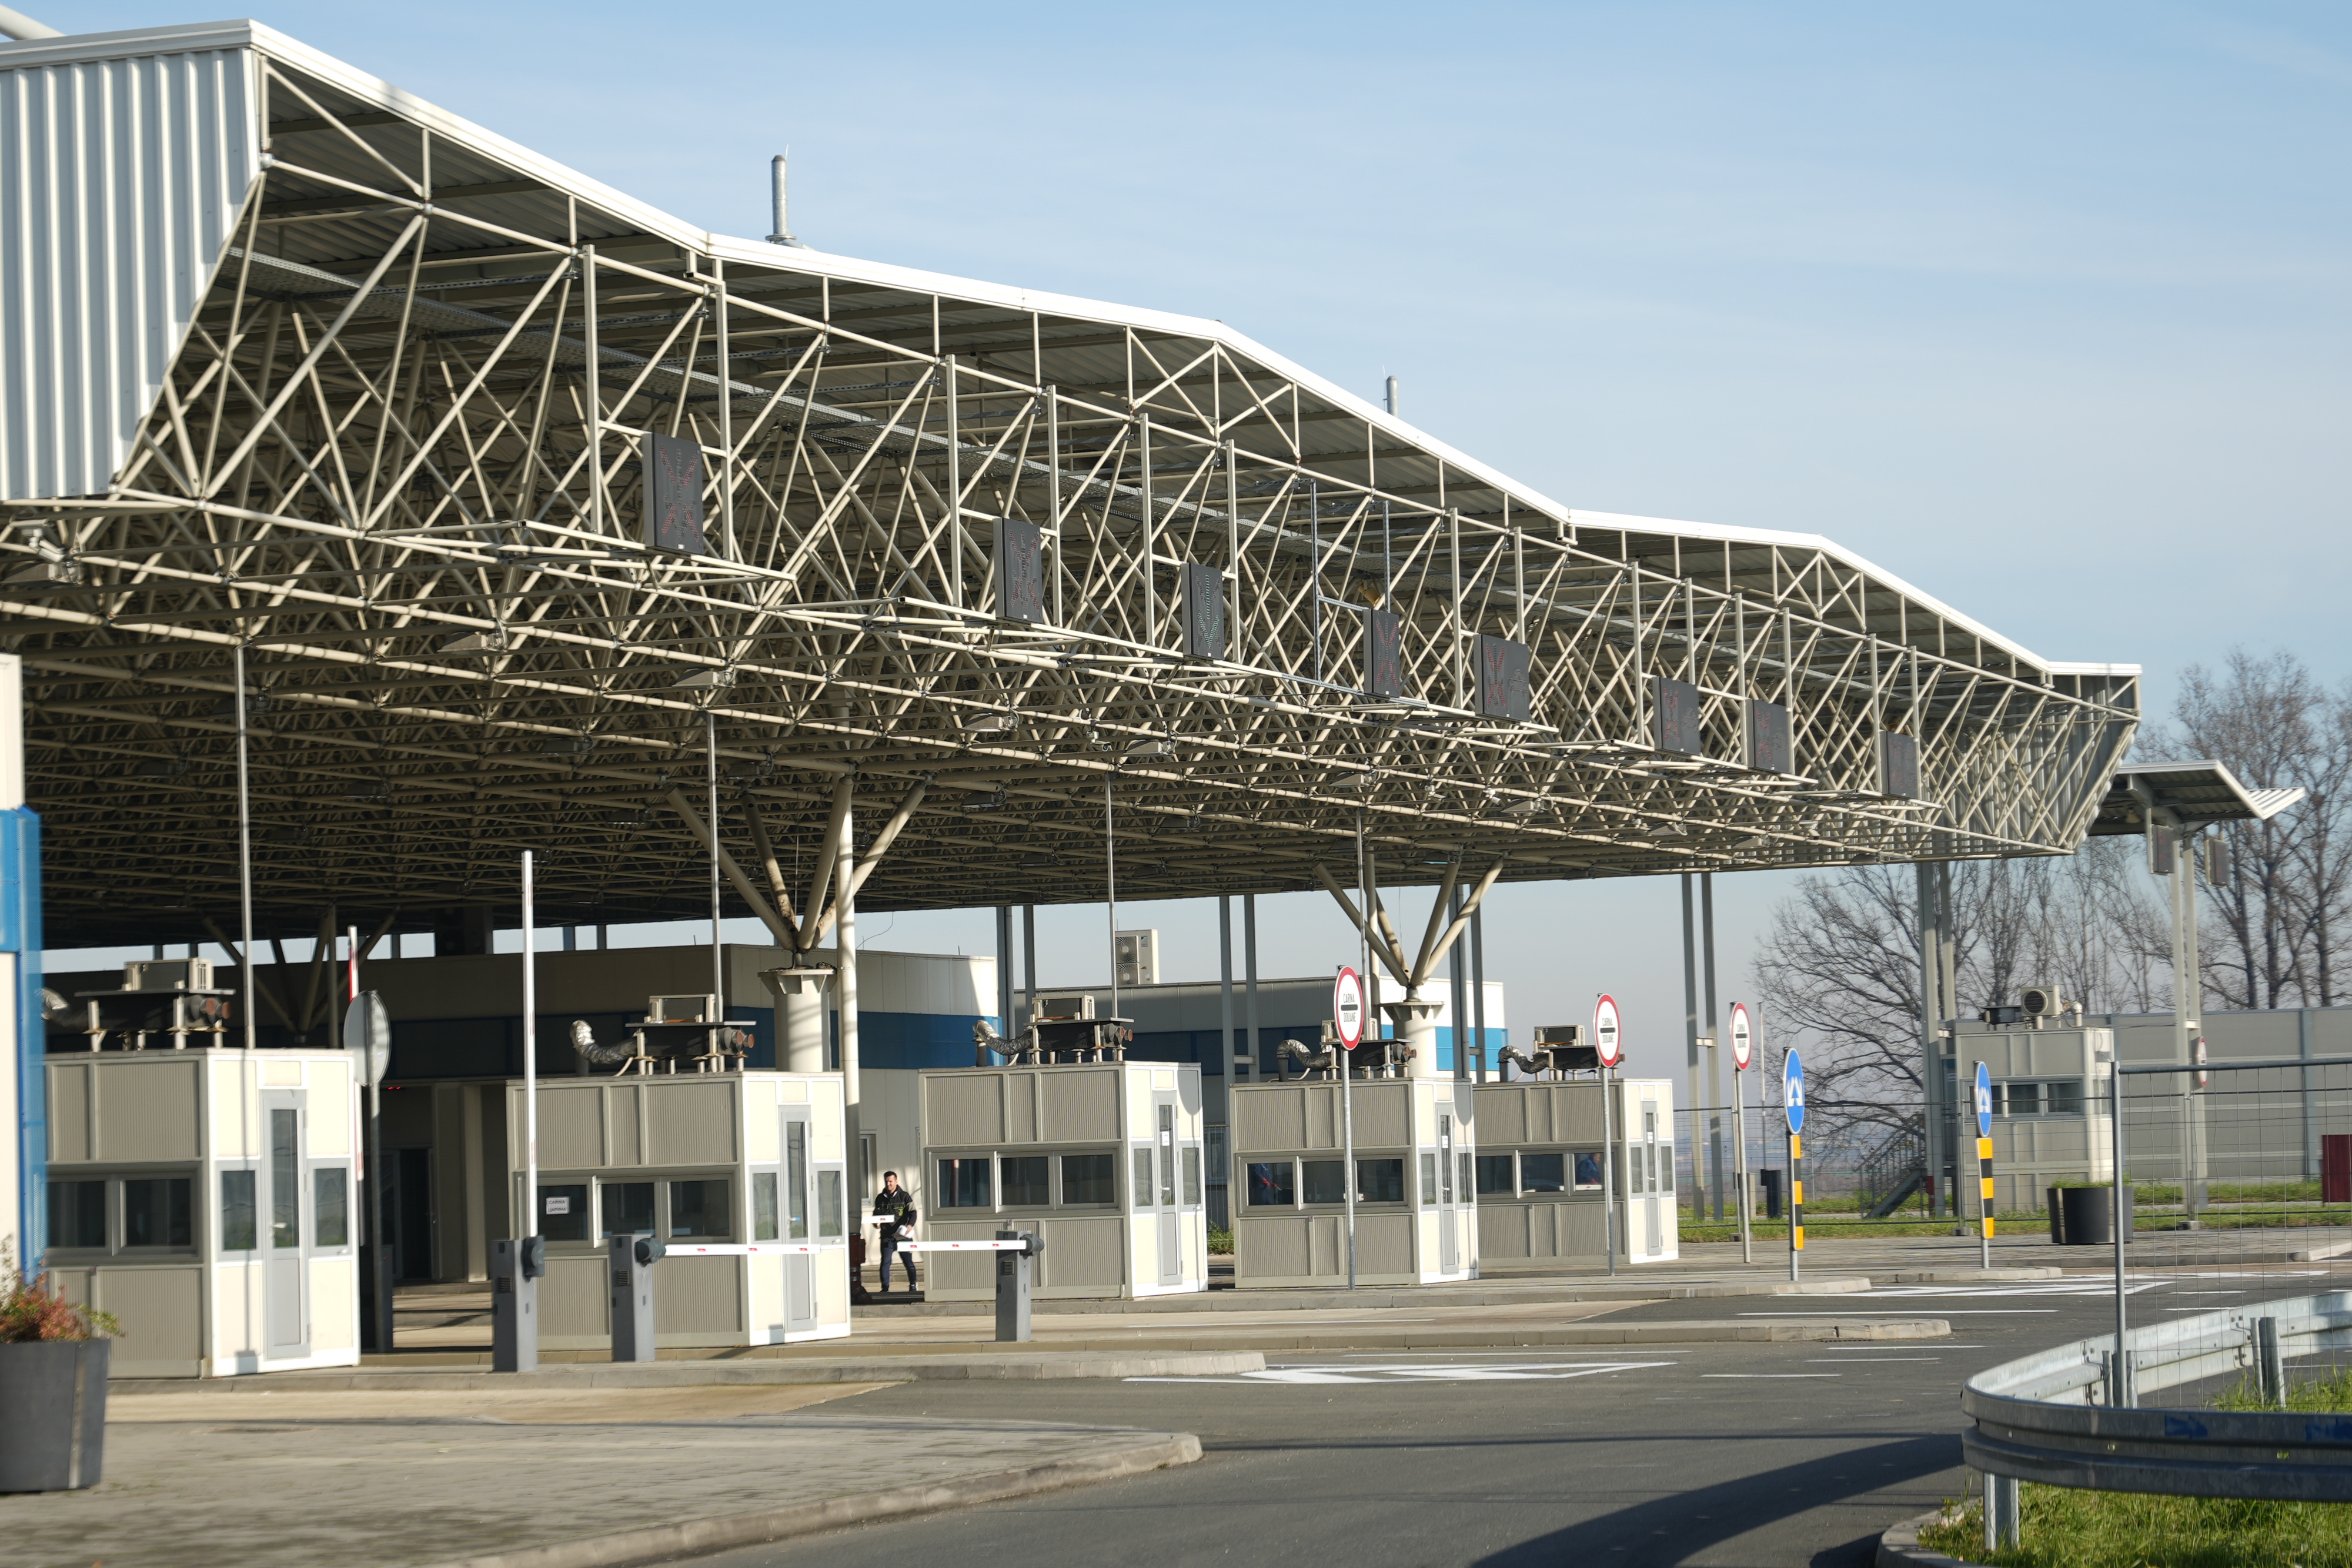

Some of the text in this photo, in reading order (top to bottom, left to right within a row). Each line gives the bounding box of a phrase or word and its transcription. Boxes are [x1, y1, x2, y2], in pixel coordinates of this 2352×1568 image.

[1343, 993, 1355, 1003] CARINA
[1343, 1012, 1356, 1022] DOUANE
[1602, 1018, 1613, 1027] CARINA
